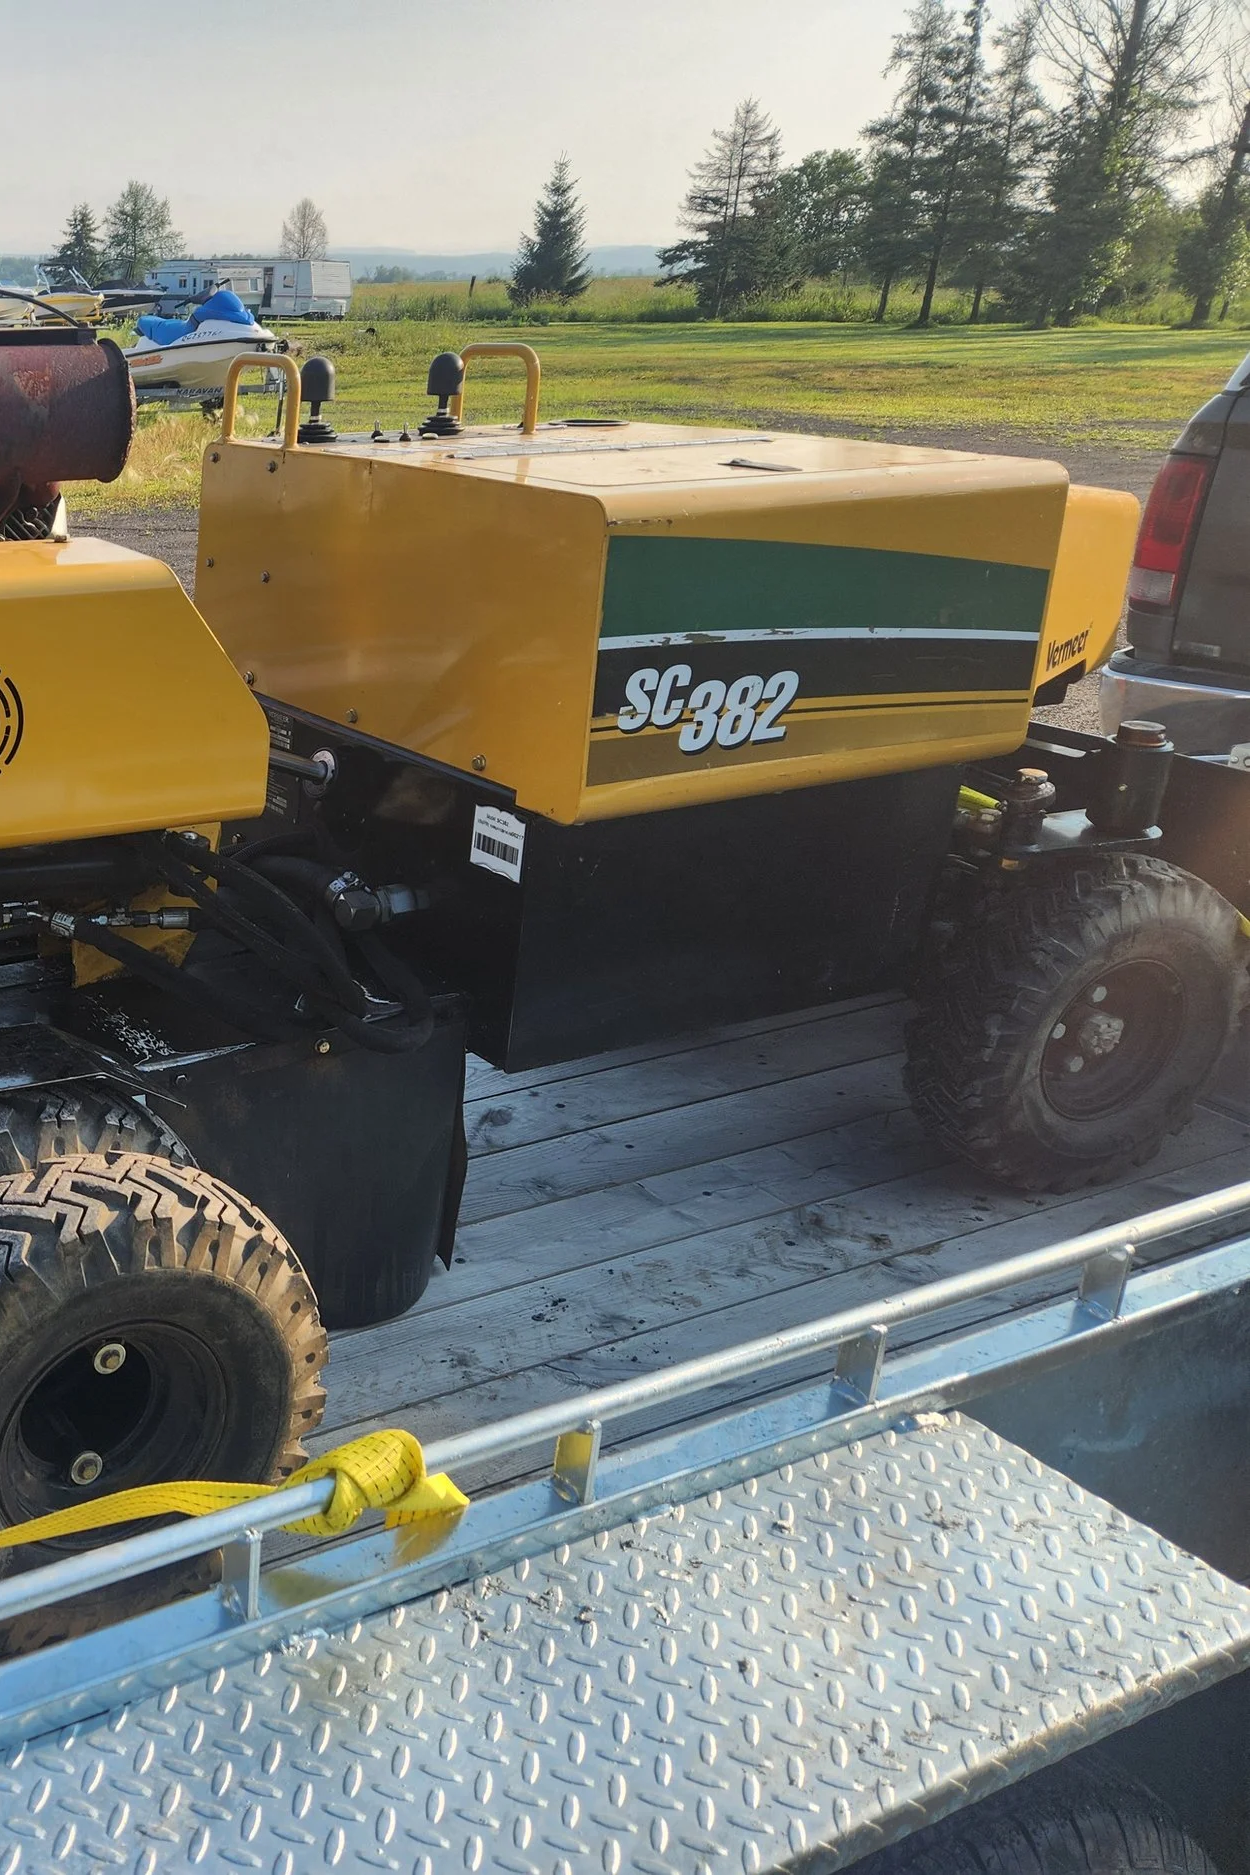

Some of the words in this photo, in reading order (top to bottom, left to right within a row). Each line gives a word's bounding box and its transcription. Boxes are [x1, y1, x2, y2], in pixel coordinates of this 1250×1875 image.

[177, 386, 223, 396] KARAVAN
[1046, 630, 1089, 672] Vermeer
[617, 664, 800, 756] SC382
